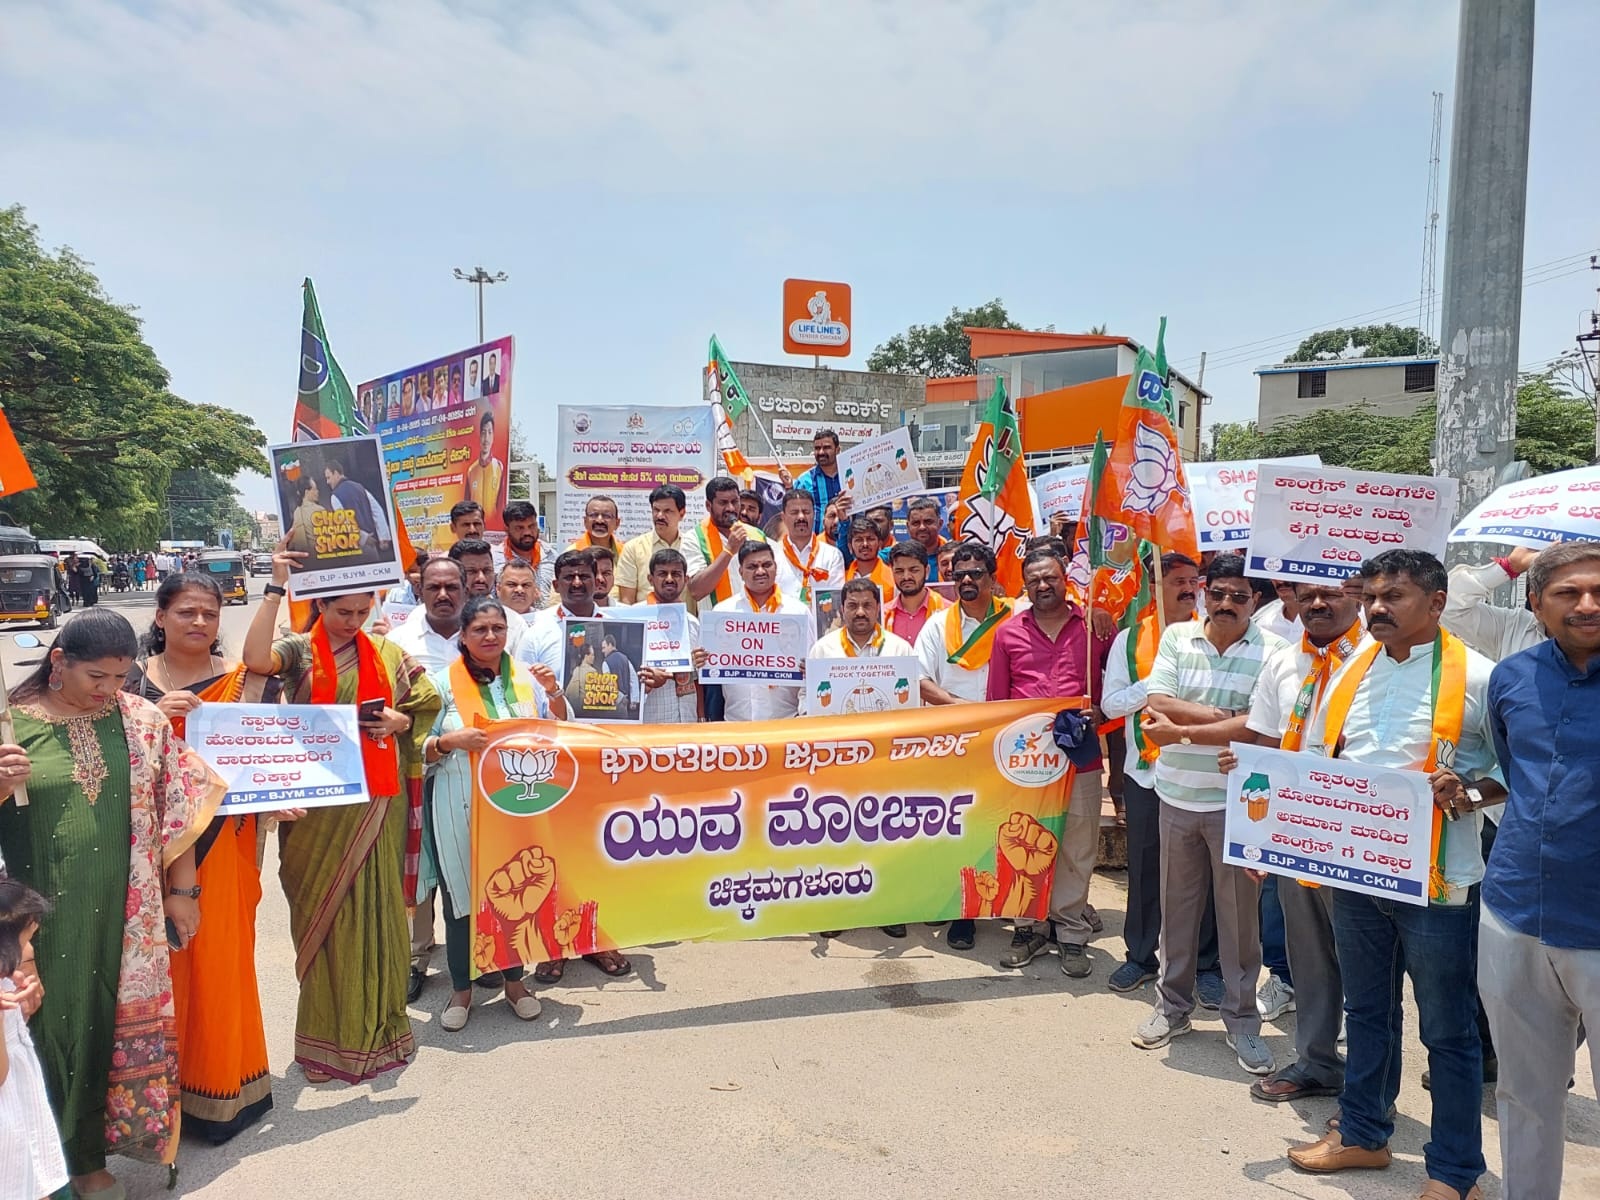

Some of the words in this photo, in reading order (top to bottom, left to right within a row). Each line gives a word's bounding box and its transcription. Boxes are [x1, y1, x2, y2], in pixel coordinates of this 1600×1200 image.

[798, 324, 815, 333] LIFE
[816, 325, 842, 335] LINE'S
[834, 398, 893, 418] ಪಾರ್ಕ್
[572, 440, 625, 456] ನಗರಸಭಾ
[630, 440, 703, 455] ಕಾರ್ಯಾಲಯ
[1218, 469, 1257, 486] SHA
[1275, 477, 1345, 495] ಕಾಂಗ್ರೆಸ್
[1356, 483, 1436, 500] ಕೇಡಿಗಳೇ
[311, 509, 357, 527] CHOR
[1372, 507, 1413, 528] ನಿಮ್ಮ
[314, 522, 360, 536] MACHAYE
[1289, 522, 1319, 540] ಕೈಗೆ
[1523, 529, 1564, 543] BJYM
[315, 533, 360, 553] SHOR
[1321, 547, 1362, 563] ಬೇಡಿ
[320, 574, 336, 582] BJP
[343, 571, 366, 579] BJYM
[372, 567, 391, 576] CKM
[1288, 565, 1316, 574] BJP
[725, 620, 780, 634] SHAME
[741, 637, 763, 650] ON
[708, 653, 796, 668] CONGRESS
[585, 672, 618, 685] CHOR
[724, 669, 740, 677] BJP
[746, 670, 768, 678] BJYM
[774, 671, 793, 679] CKM
[857, 670, 897, 678] TOGETHER
[583, 692, 618, 705] SHOR
[241, 715, 309, 731] ಸ್ವಾತಂತ್ರ್ಯ
[205, 733, 294, 746] ಹೋರಾಟದ
[216, 750, 333, 765] ವಾರಸುದಾರರಿಗೆ
[601, 743, 768, 784] ಭಾರತೀಯ
[784, 738, 875, 775] ಜನತಾ
[889, 731, 980, 761] ಪಾರ್ಟಿ
[1008, 753, 1060, 769] BJYM
[1309, 769, 1378, 797] ಸ್ವಾತಂತ್ರ್ಯ
[231, 794, 258, 803] BJP
[269, 790, 305, 800] BJYM
[316, 786, 345, 796] CKM
[1277, 787, 1410, 821] ಹೋರಾಟಗಾರರಿಗೆ
[603, 791, 742, 861] ಯುವ
[768, 787, 974, 847] ಮೋರ್ಚಾ
[1276, 810, 1343, 833] ಅವಮಾನ
[1350, 824, 1409, 845] ಮಾಡಿದ
[1271, 832, 1334, 855] ಕಾಂಗ್ರೆಸ್
[1341, 845, 1355, 859] ಗೆ
[1362, 851, 1412, 874] ದಿಕ್ಕಾರ
[1268, 854, 1296, 866] BJP
[1308, 862, 1349, 880] BJYM
[1362, 874, 1399, 890] CKM
[708, 864, 873, 920] ಚಿಕ್ಕಮಗಳೂರು
